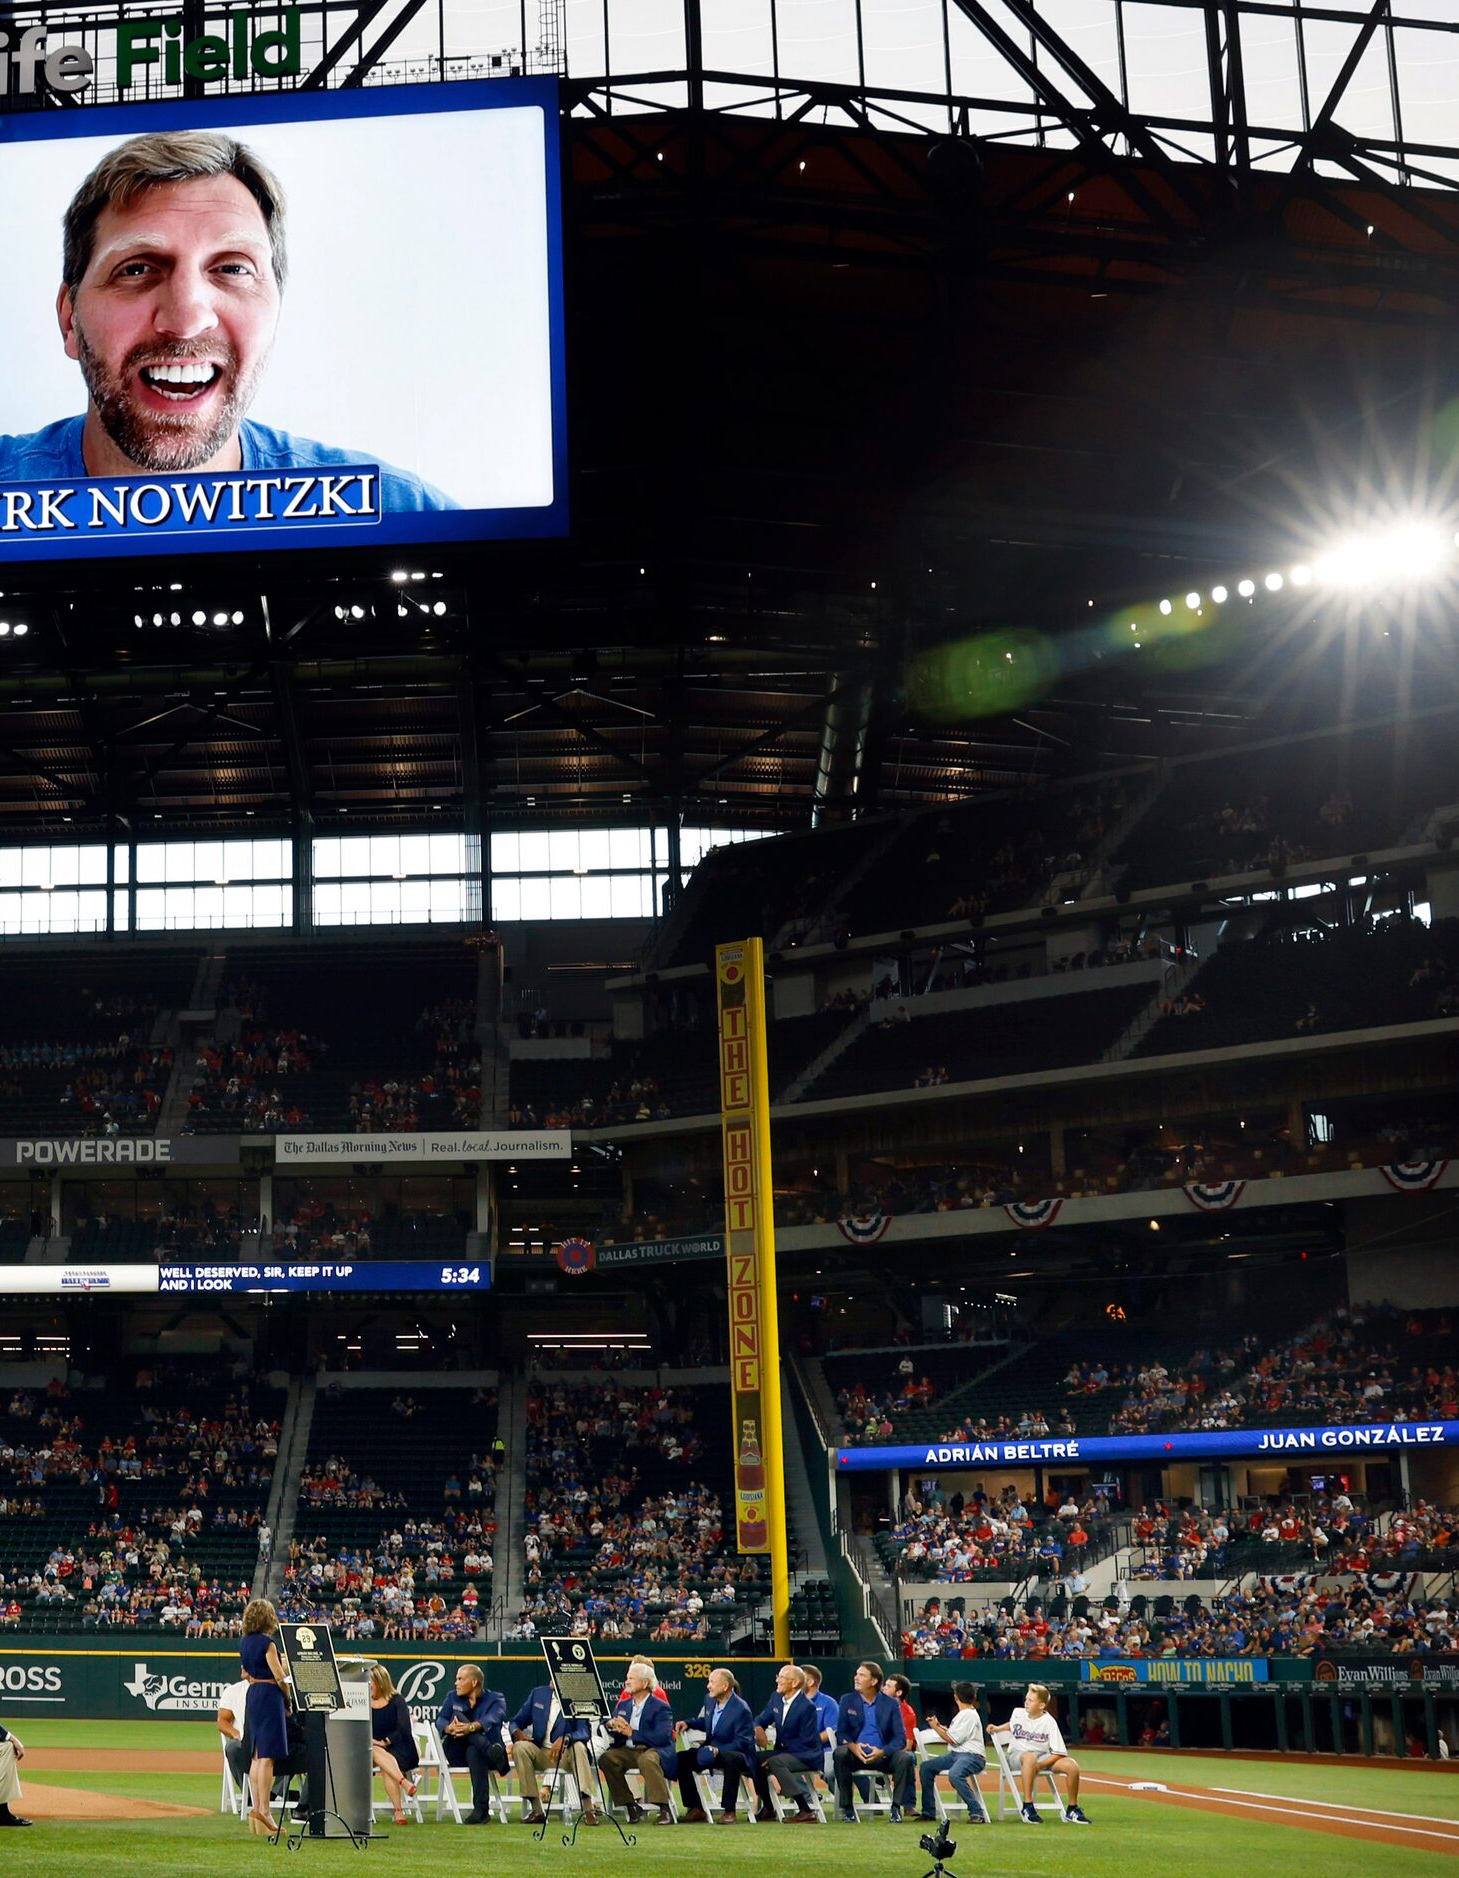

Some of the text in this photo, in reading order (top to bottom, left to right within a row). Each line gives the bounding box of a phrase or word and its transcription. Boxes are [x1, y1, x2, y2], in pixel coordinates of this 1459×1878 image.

[117, 6, 301, 89] Field
[87, 474, 375, 526] NOWITZKI
[15, 1139, 171, 1163] POWERADE
[283, 1141, 303, 1154] The
[306, 1140, 339, 1153] Dallas
[341, 1140, 387, 1154] Morning
[388, 1140, 417, 1152] News
[431, 1142, 460, 1153] Real.
[493, 1140, 563, 1152] Journalism.
[725, 1009, 757, 1390] THE HOT ZONE
[599, 1241, 720, 1262] DALLAS TRUCK WORLD
[160, 1266, 480, 1284] WELL DESERVED, SIR, KEEP IT UP 5:34
[160, 1279, 232, 1290] AND I LOOK
[1258, 1426, 1444, 1451] JUAN GONZÁLEZ
[925, 1440, 1079, 1463] ADRIÁN BELTRÉ
[684, 1663, 712, 1678] 326
[1147, 1662, 1254, 1681] HOW TO NACHO
[168, 1676, 232, 1698] Germ
[176, 1699, 219, 1708] INSUR
[408, 1705, 443, 1720] PORT
[1012, 1723, 1049, 1743] Rangers
